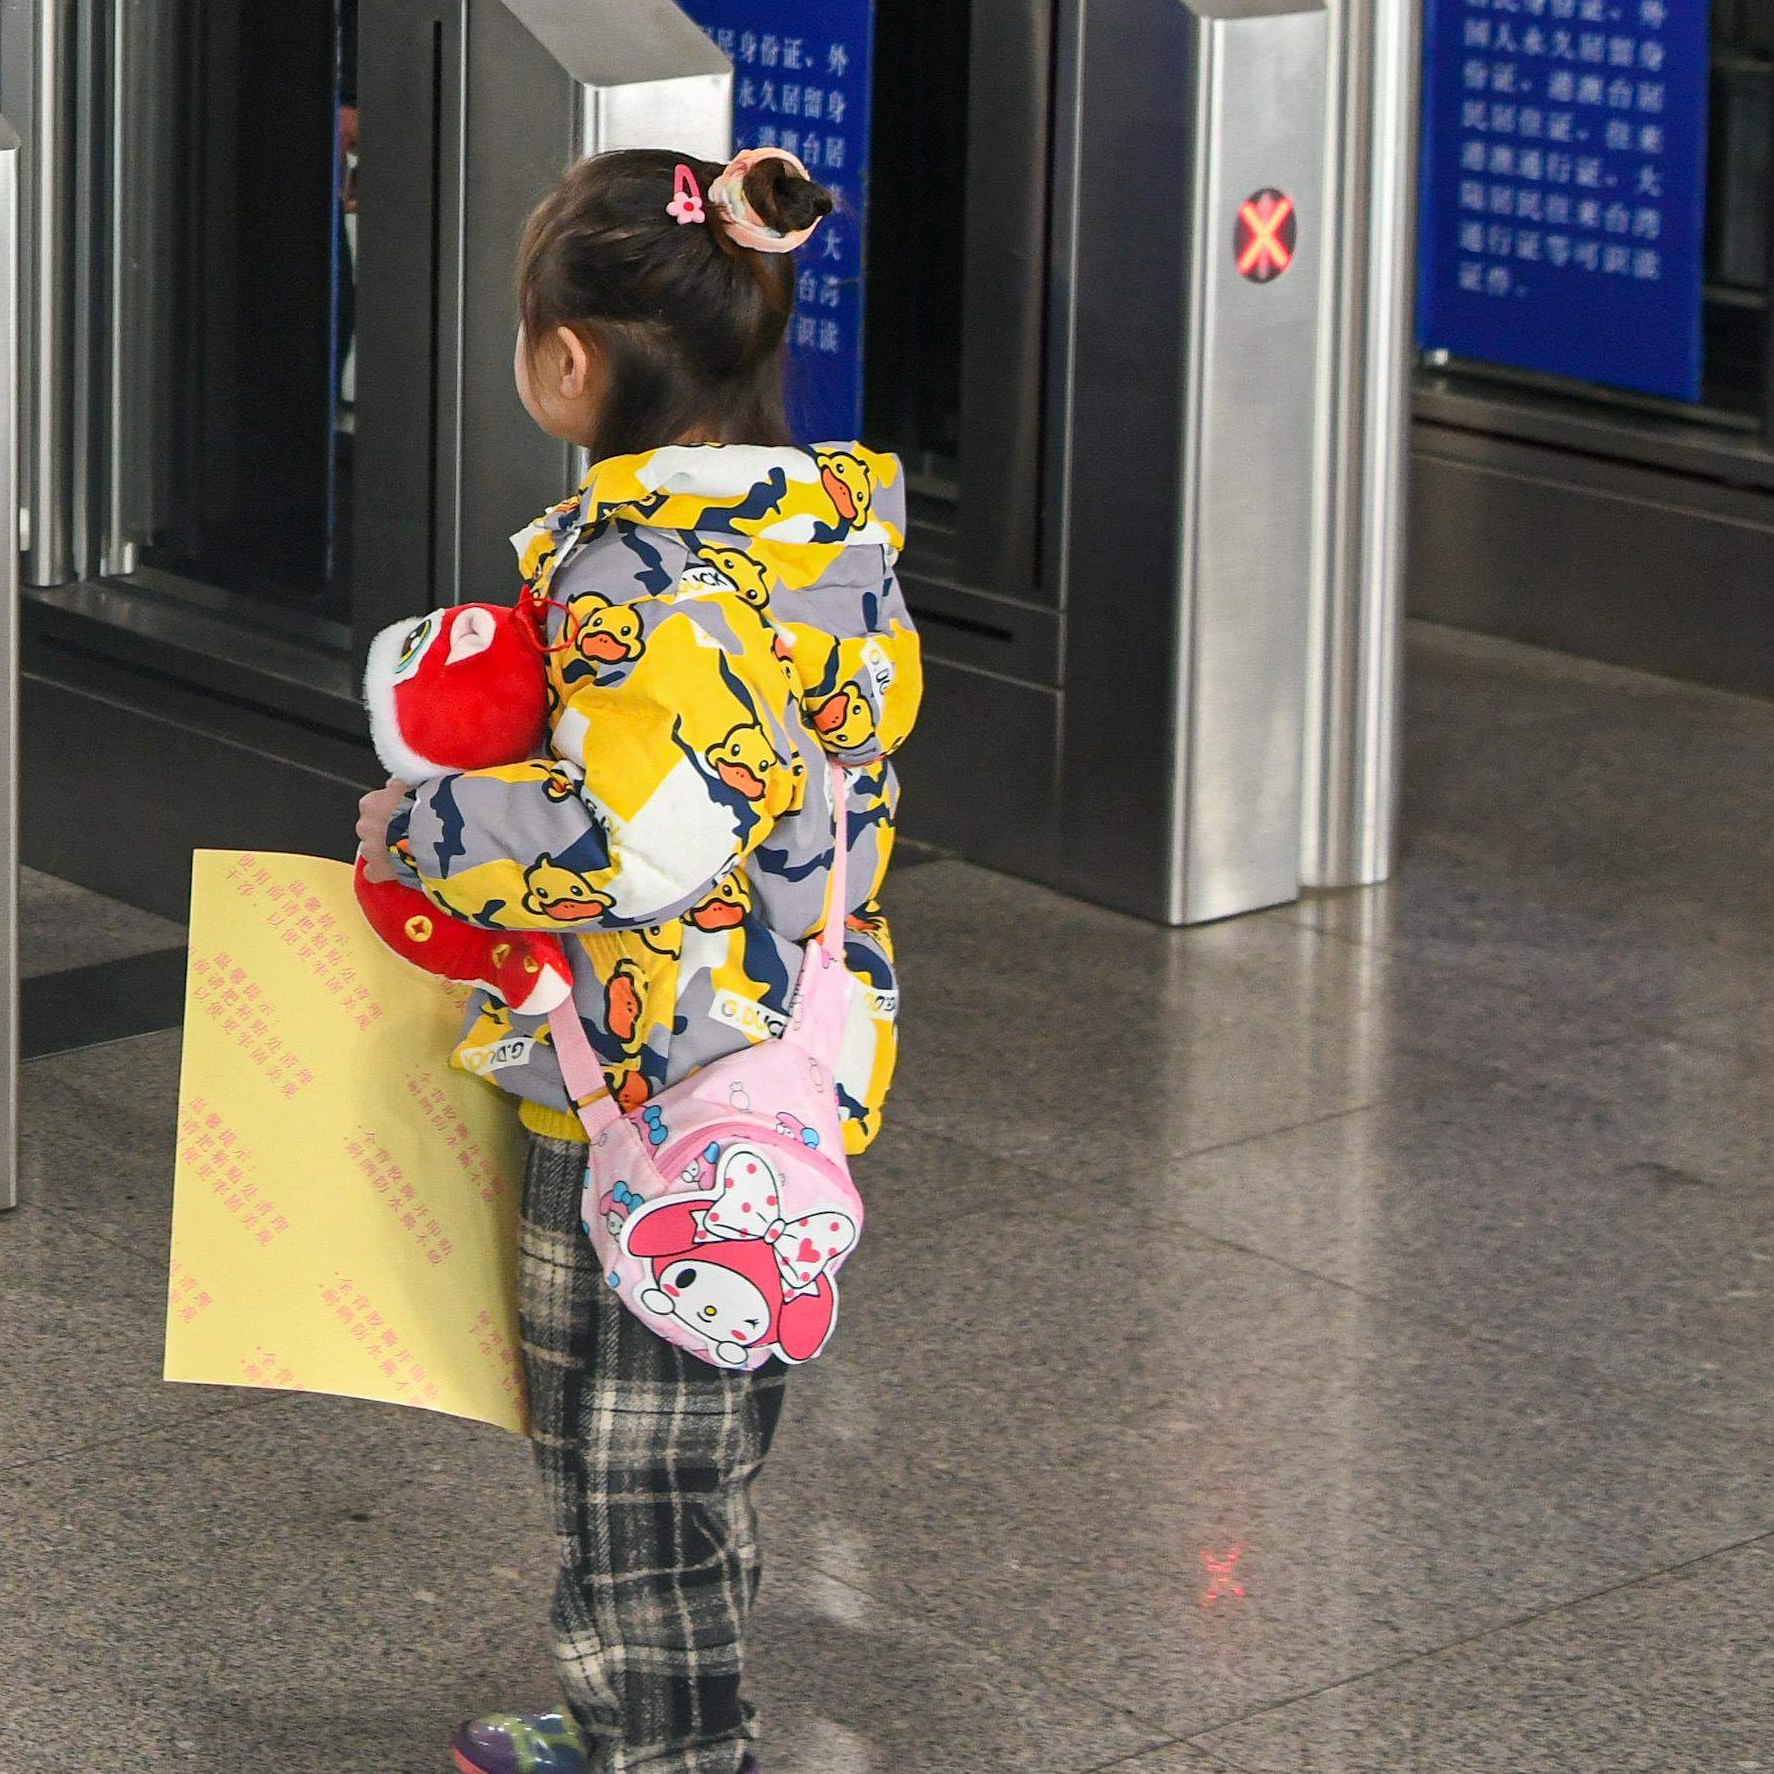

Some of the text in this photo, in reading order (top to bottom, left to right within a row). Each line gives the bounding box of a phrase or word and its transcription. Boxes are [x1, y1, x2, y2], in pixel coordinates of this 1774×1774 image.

[706, 26, 848, 77] 民身份证、外
[721, 999, 785, 1038] G.DUC
